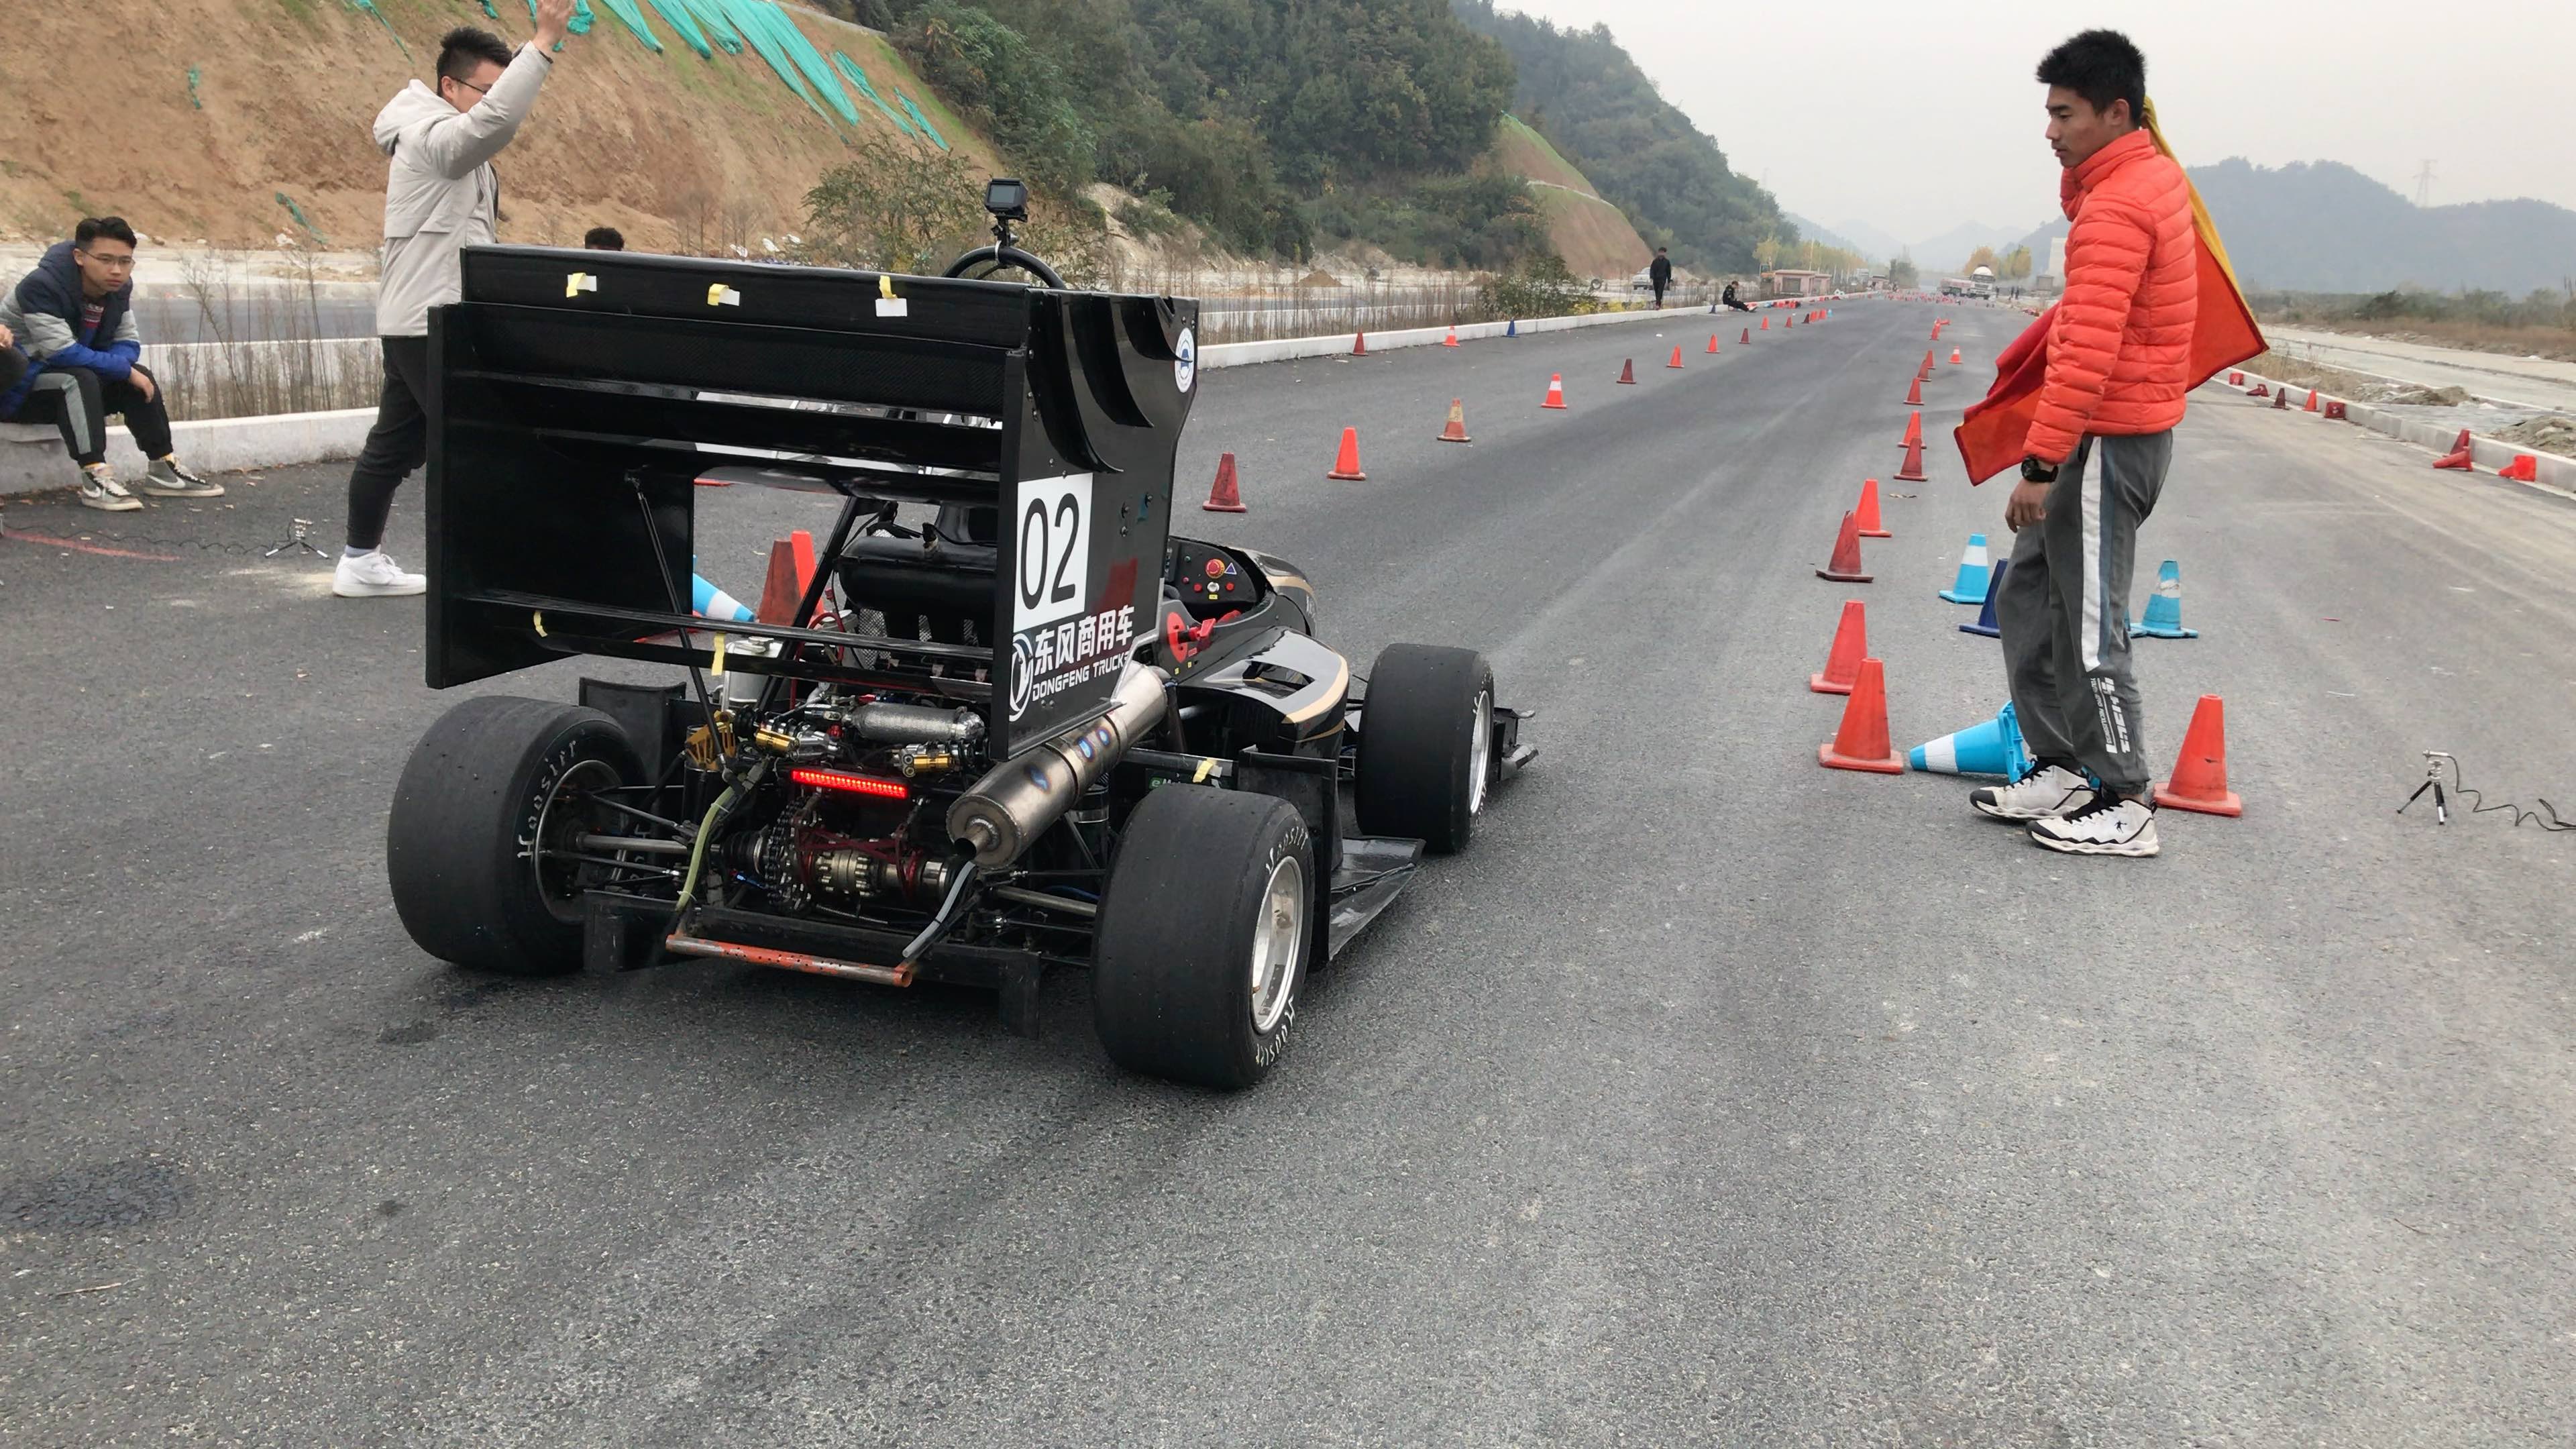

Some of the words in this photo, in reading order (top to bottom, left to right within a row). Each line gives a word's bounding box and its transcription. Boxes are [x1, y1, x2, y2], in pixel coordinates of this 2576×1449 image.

[1020, 493, 1079, 610] 02
[1034, 604, 1134, 676] 东风商用车
[1032, 665, 1089, 702] DONGFENG
